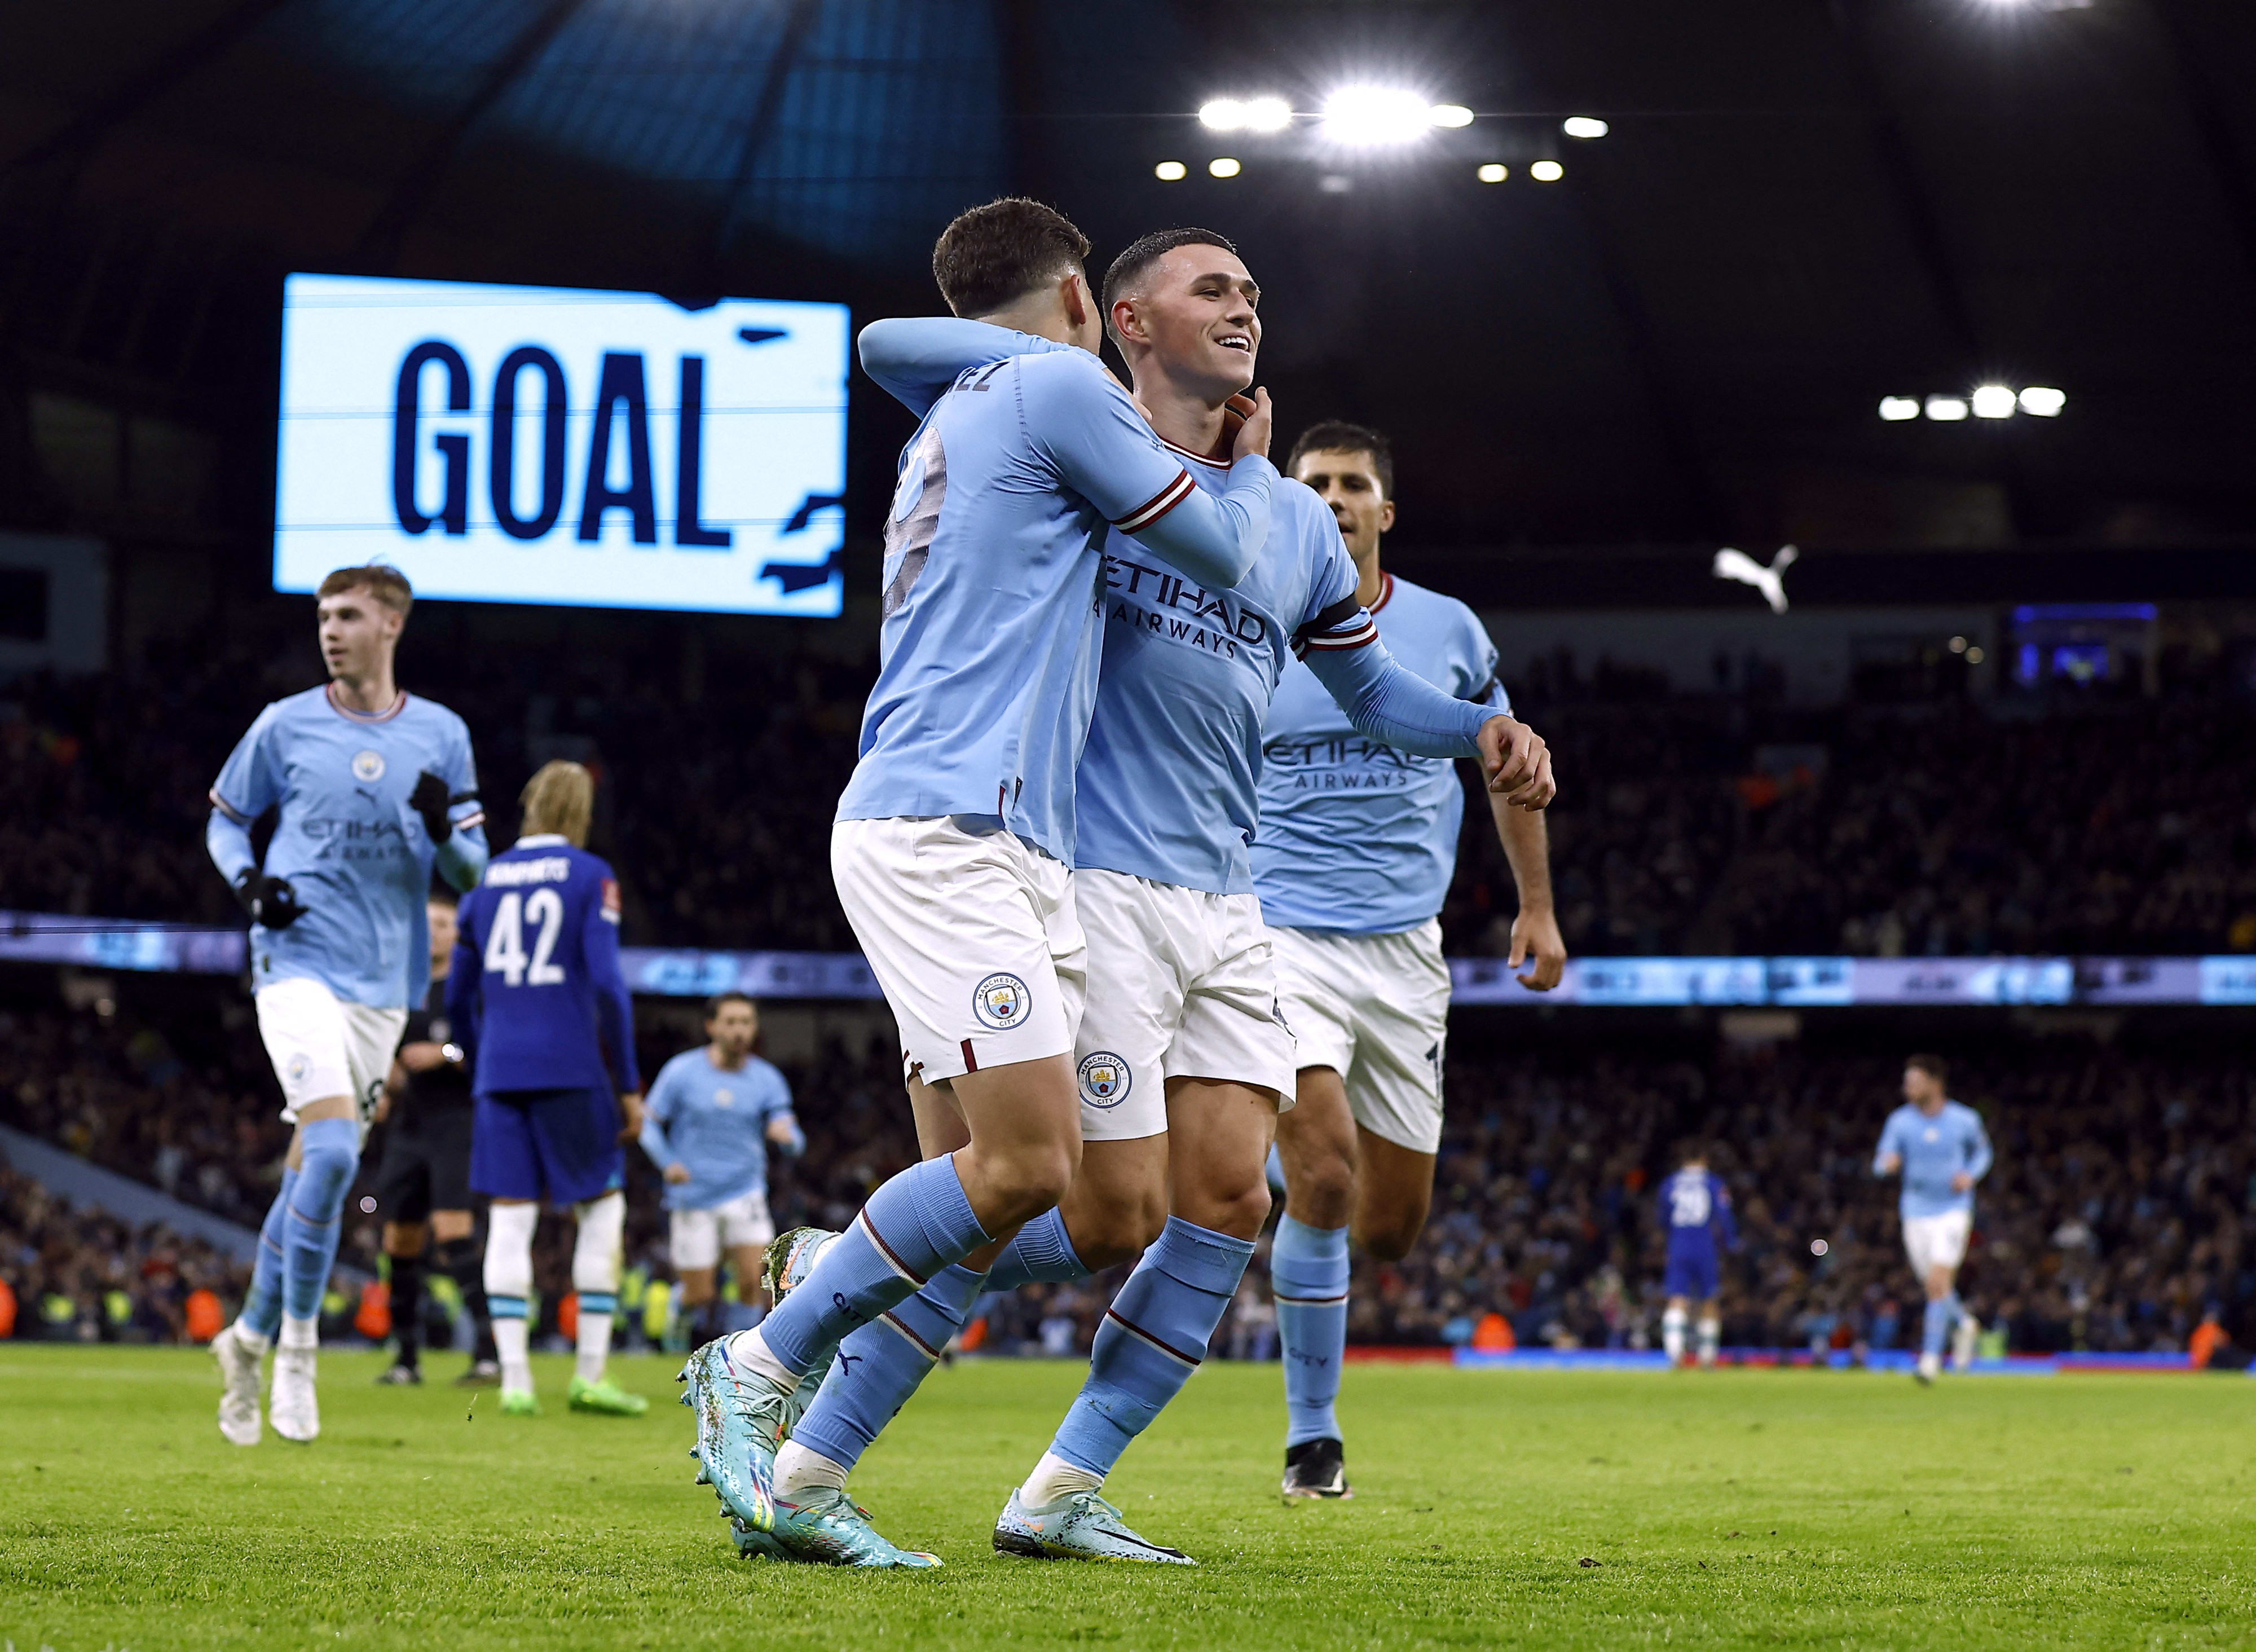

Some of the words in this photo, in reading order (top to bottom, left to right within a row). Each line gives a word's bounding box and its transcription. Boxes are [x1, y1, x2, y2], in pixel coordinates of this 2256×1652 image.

[394, 341, 732, 548] GOAL
[1106, 554, 1266, 645] ETIHAD
[1112, 603, 1237, 659] AIRWAYS
[1294, 773, 1407, 788] AIRWAYS
[483, 887, 565, 986] 42
[977, 977, 1023, 999] MANCHESTER
[999, 1018, 1016, 1027] CITY
[1081, 1056, 1125, 1075] MANCHESTER
[832, 1292, 870, 1324] CIT
